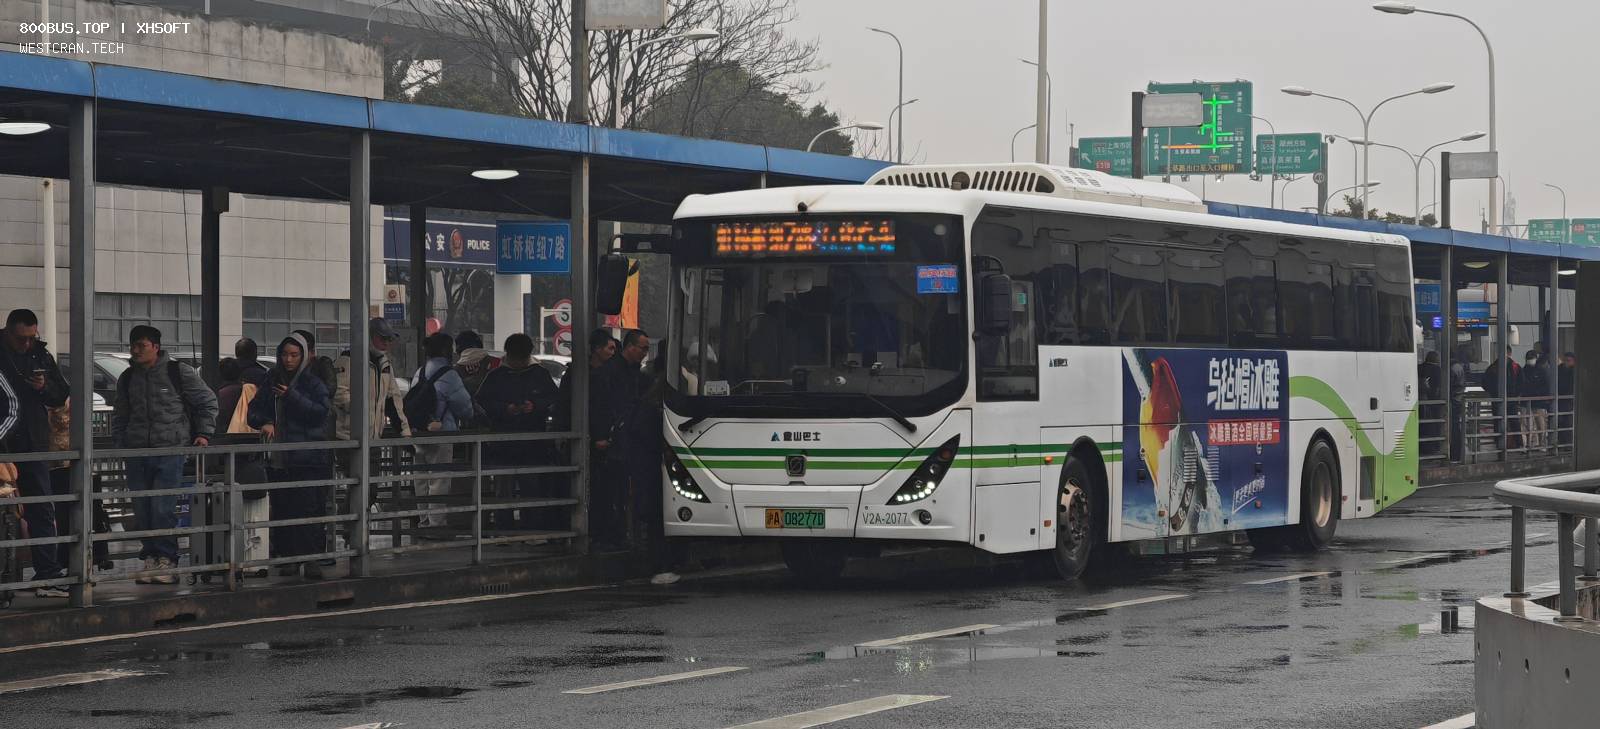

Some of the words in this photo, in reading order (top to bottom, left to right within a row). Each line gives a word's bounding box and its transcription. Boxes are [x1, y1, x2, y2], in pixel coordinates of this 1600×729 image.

[467, 239, 491, 250] POLICE
[501, 233, 566, 262] 虹桥枢纽7路
[1207, 357, 1280, 410] 乌毡帽冰雕
[862, 512, 908, 525] V2A-2077
